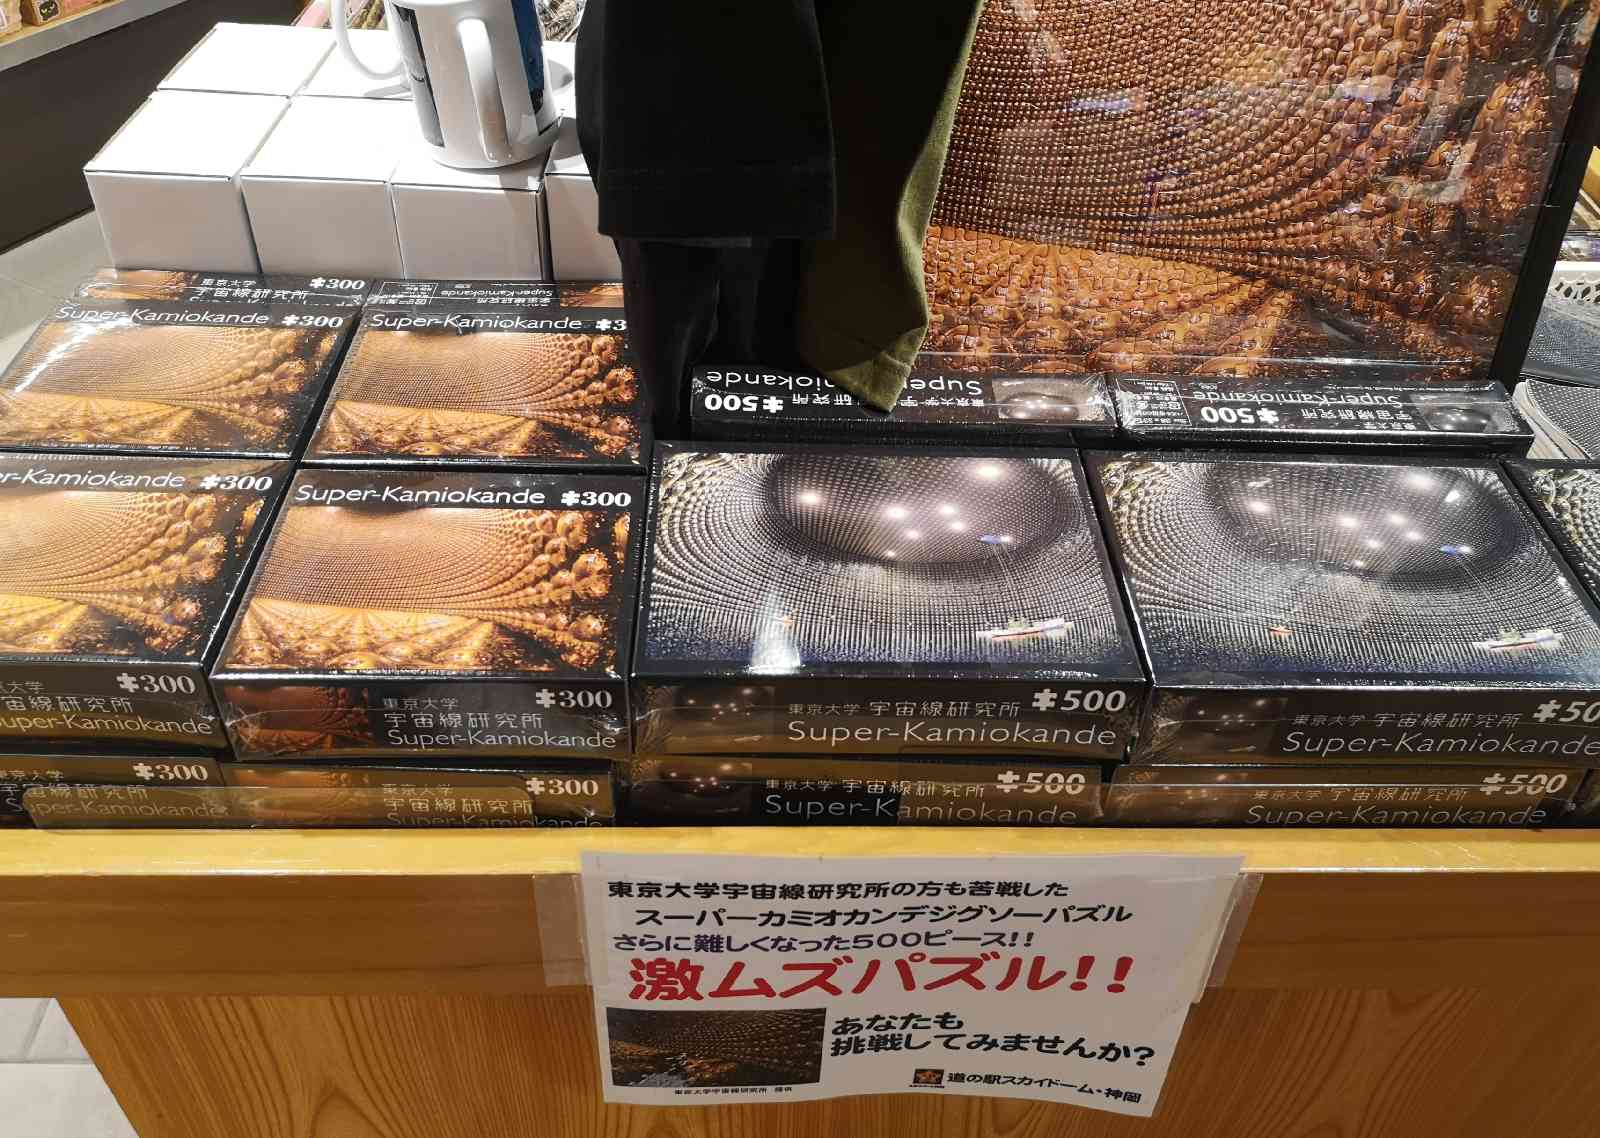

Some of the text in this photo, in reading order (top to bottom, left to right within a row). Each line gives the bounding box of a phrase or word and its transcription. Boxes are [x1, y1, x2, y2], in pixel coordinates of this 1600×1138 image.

[324, 279, 365, 290] 300
[56, 306, 269, 325] Super-Kamiokande
[298, 314, 344, 328] 300
[370, 313, 583, 331] Super-Kamiokande
[704, 394, 758, 412] 500
[1193, 390, 1403, 409] Super-Kamiokande
[1200, 406, 1252, 424] 500
[0, 468, 185, 488] r-Kamiokande
[219, 474, 273, 491] 300
[295, 484, 546, 506] Super-Kamiokande
[581, 491, 632, 507] 300
[0, 680, 45, 694] 大学
[140, 674, 196, 694] 300
[559, 689, 612, 708] 300
[1061, 688, 1126, 713] 500
[789, 700, 1021, 718] 東京大学 宇宙線研究所
[0, 714, 213, 735] uper-Kamiokande
[384, 712, 544, 729] 宇宙線研究所
[1374, 712, 1522, 729] 宇宙線研究所
[387, 729, 616, 750] Super-Kamiokande
[787, 720, 1117, 747] Super-Kamiokande
[1282, 731, 1600, 758] Super-Kamiokande
[155, 764, 209, 781] 300
[548, 779, 599, 796] 300
[842, 778, 985, 799] 宇宙線研究所
[1022, 773, 1087, 795] 500
[1504, 773, 1568, 796] 500
[383, 798, 534, 815] 宇宙線研究所
[765, 795, 1079, 826] Super-Kamiokande
[1246, 804, 1547, 826] Super-Kamiokande
[607, 880, 1069, 900] 東京大学宇宙線研究所の方も苦戦した
[635, 904, 1133, 927] スーパーカミオカンデジグソーパズル
[613, 929, 1035, 953] さらに難しくなった500ピース!!
[628, 951, 1134, 1001] 激ムズパズル!!
[831, 1011, 964, 1036] あなたも
[830, 1033, 1155, 1067] 挑戦してみませんか?
[947, 1072, 1142, 1104] 道の駅スカイドーム・神岡
